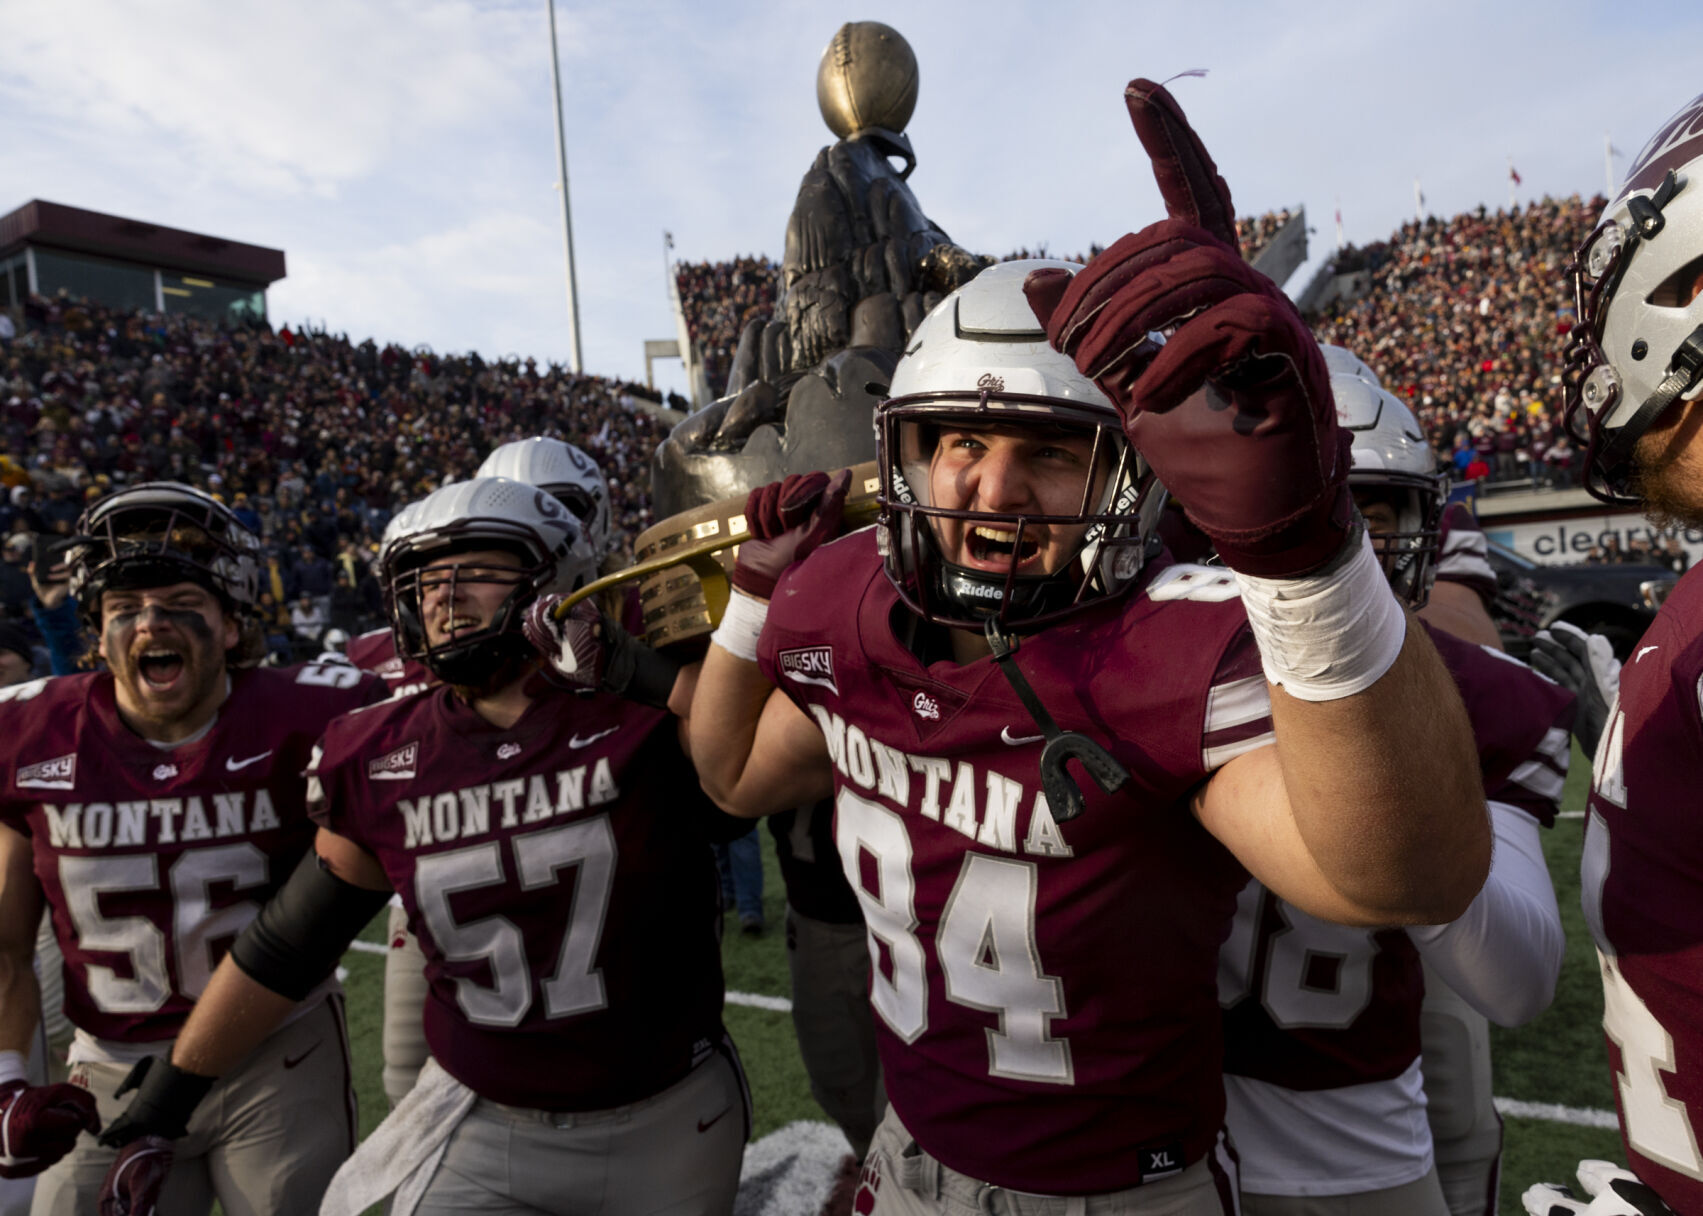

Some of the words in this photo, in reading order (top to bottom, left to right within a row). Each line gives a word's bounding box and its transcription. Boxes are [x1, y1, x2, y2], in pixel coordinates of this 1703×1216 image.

[1085, 486, 1139, 542] Riell
[960, 582, 1014, 601] Ridde
[43, 788, 281, 849] MONTANA
[398, 757, 620, 849] MONTANA
[808, 704, 1075, 858] MONTANA
[58, 842, 270, 1013] 56
[415, 813, 619, 1027] 57
[836, 786, 1076, 1086] 84
[1150, 1151, 1175, 1169] XL
